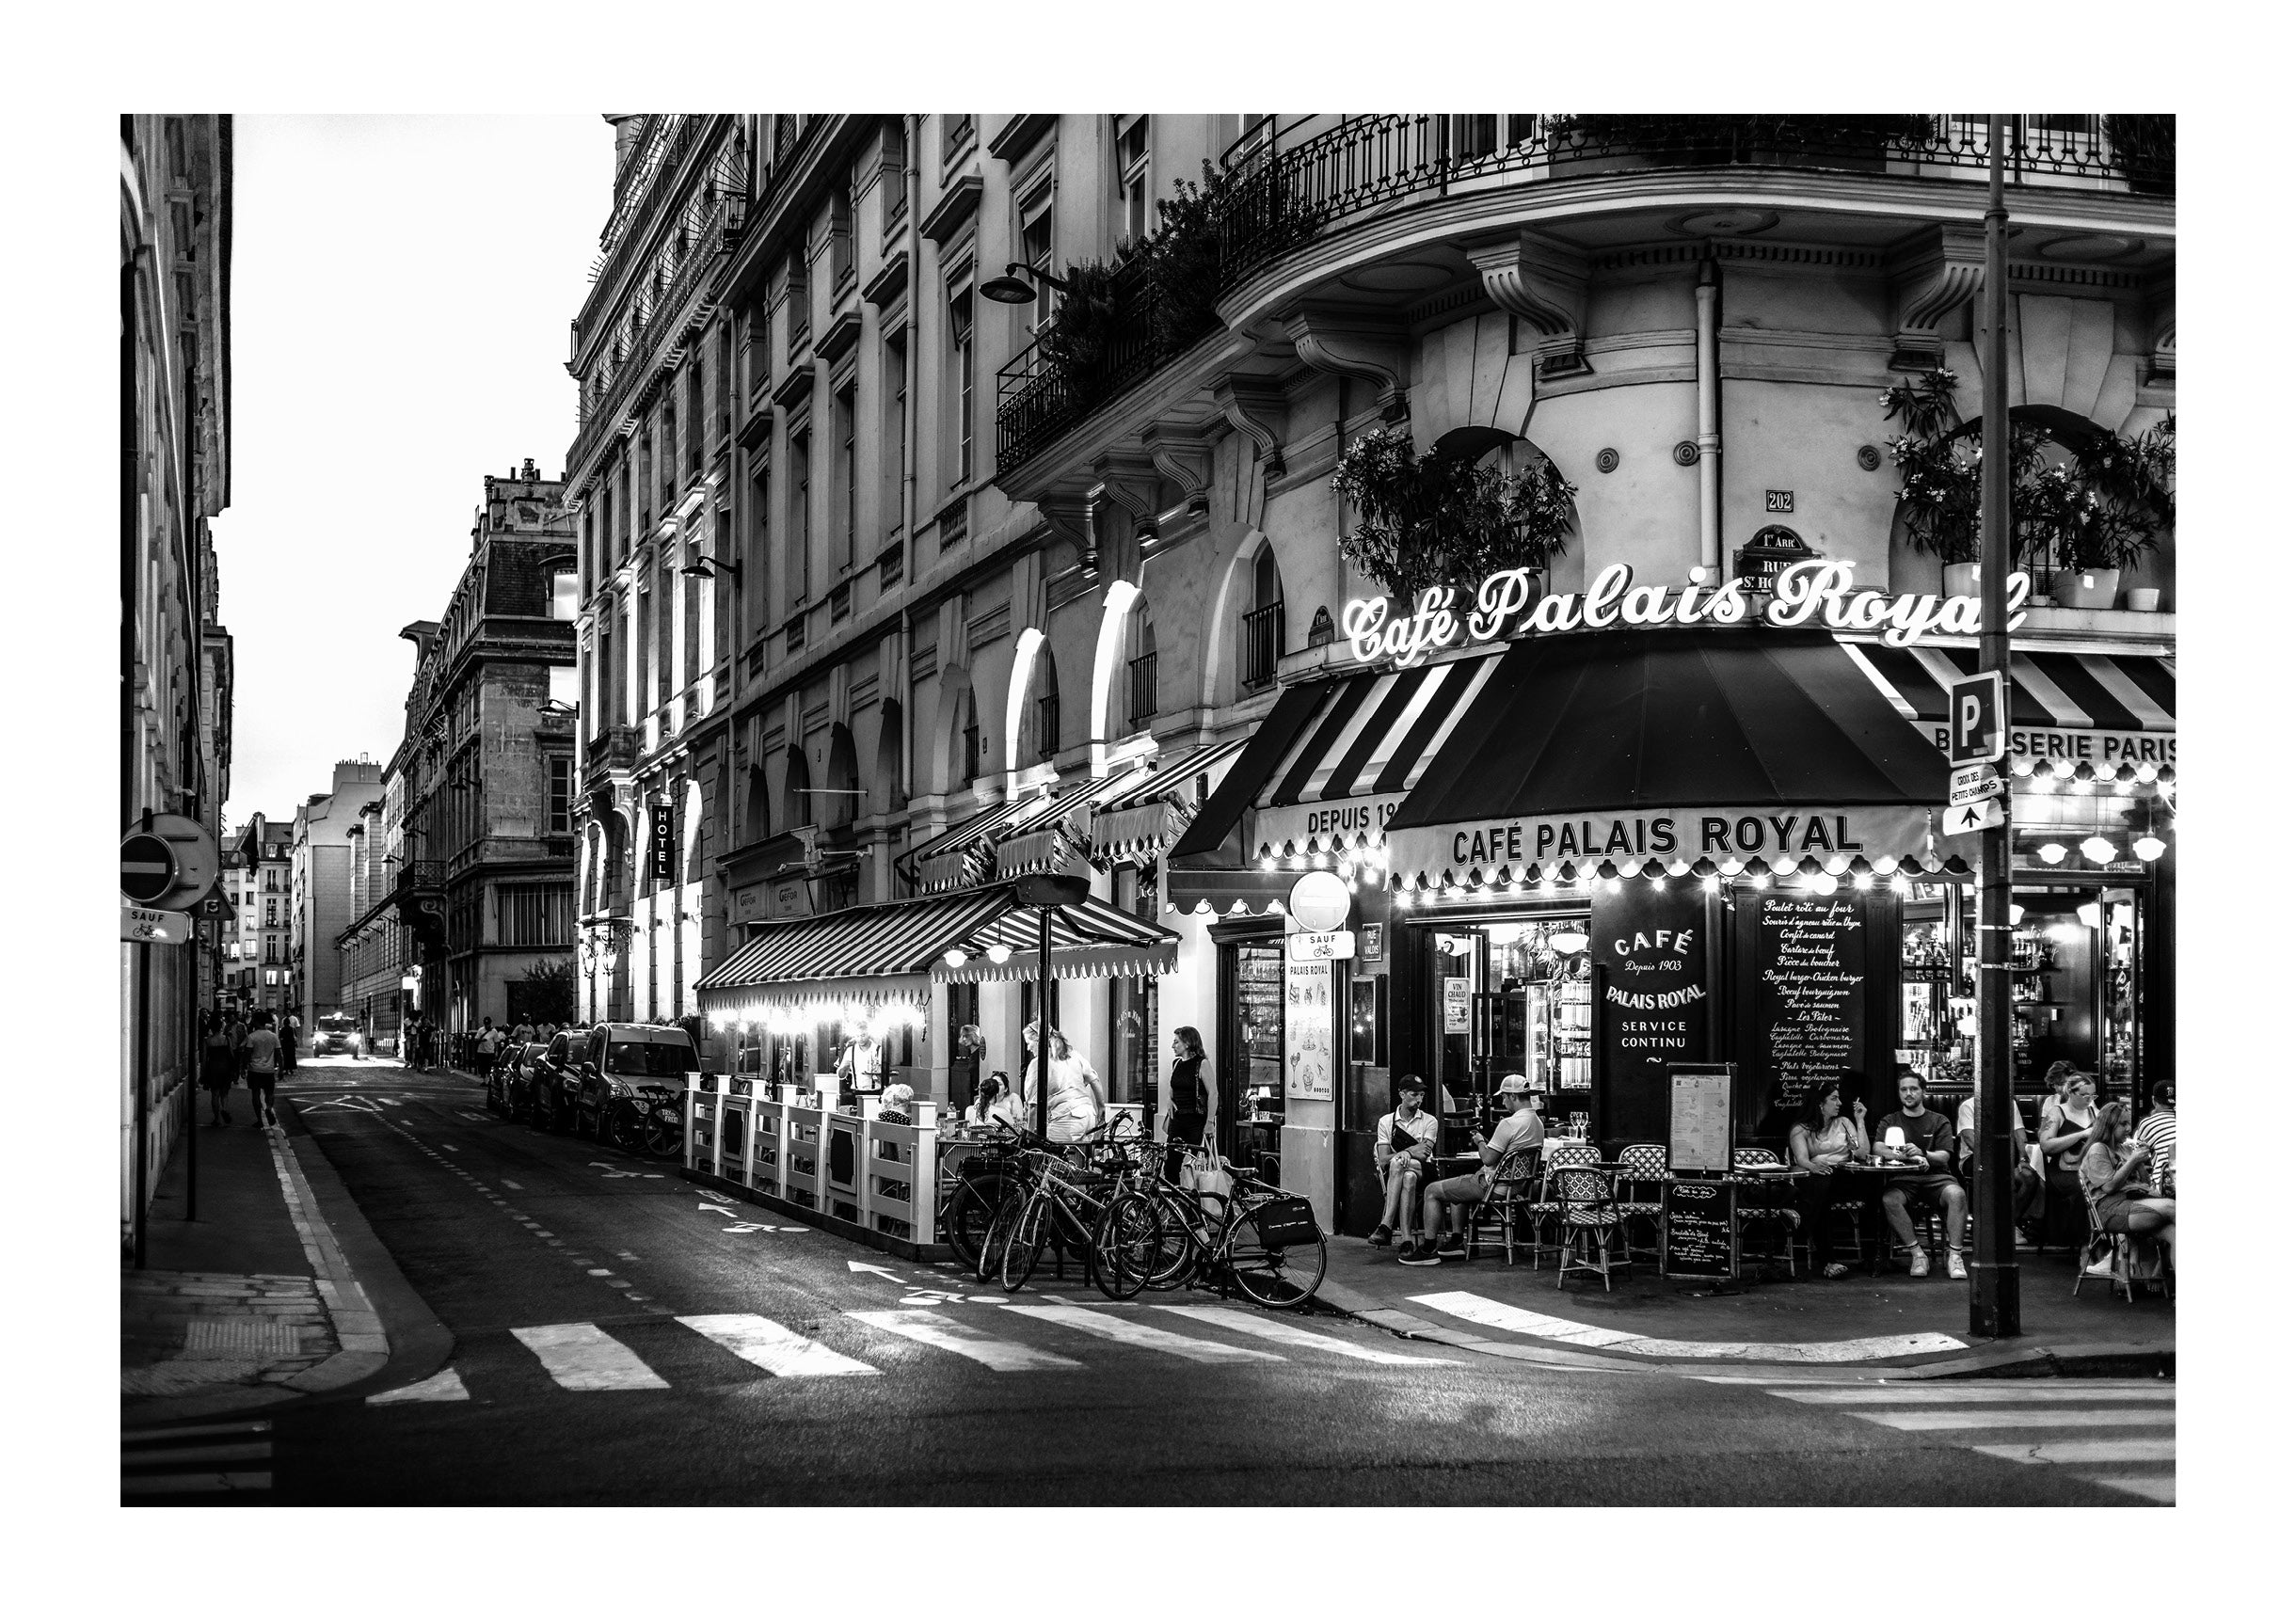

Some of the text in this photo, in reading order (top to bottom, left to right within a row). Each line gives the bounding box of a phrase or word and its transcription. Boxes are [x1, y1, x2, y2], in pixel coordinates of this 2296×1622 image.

[1769, 492, 1791, 509] 202
[1343, 560, 2030, 667] Café Palais Royal
[1962, 694, 1981, 747] P
[1936, 728, 2092, 759] BSERIE
[1957, 771, 1979, 786] CROIX DES
[1952, 780, 1997, 801] PETITS CHAMPS
[1308, 803, 1397, 835] DEPUIS 19
[658, 811, 667, 874] HOTEL
[1453, 816, 1863, 867] CAFÉ PALAIS ROYAL
[1763, 899, 1794, 912] Poulet
[1828, 900, 1855, 918] four
[132, 911, 164, 922] SAUF
[1762, 915, 1788, 926] Souris
[1310, 935, 1336, 944] SAUF
[1615, 929, 1694, 956] CAFÉ
[1779, 929, 1804, 944] Confit
[1809, 930, 1835, 939] canard
[1780, 943, 1808, 954] Tartare
[1624, 960, 1682, 976] Depuis 1903
[1810, 956, 1841, 967] boucher
[1290, 965, 1328, 975] PALAIS ROYAL
[1762, 969, 1789, 985] Royal
[1840, 971, 1864, 985] burger
[1605, 984, 1707, 1010] PALAIS ROYAL
[1802, 985, 1851, 1000] bourguignon
[1796, 1010, 1810, 1021] Les
[1621, 1021, 1686, 1031] SERVICE
[1771, 1022, 1801, 1036] Lasagne
[1621, 1037, 1685, 1047] CONTINU
